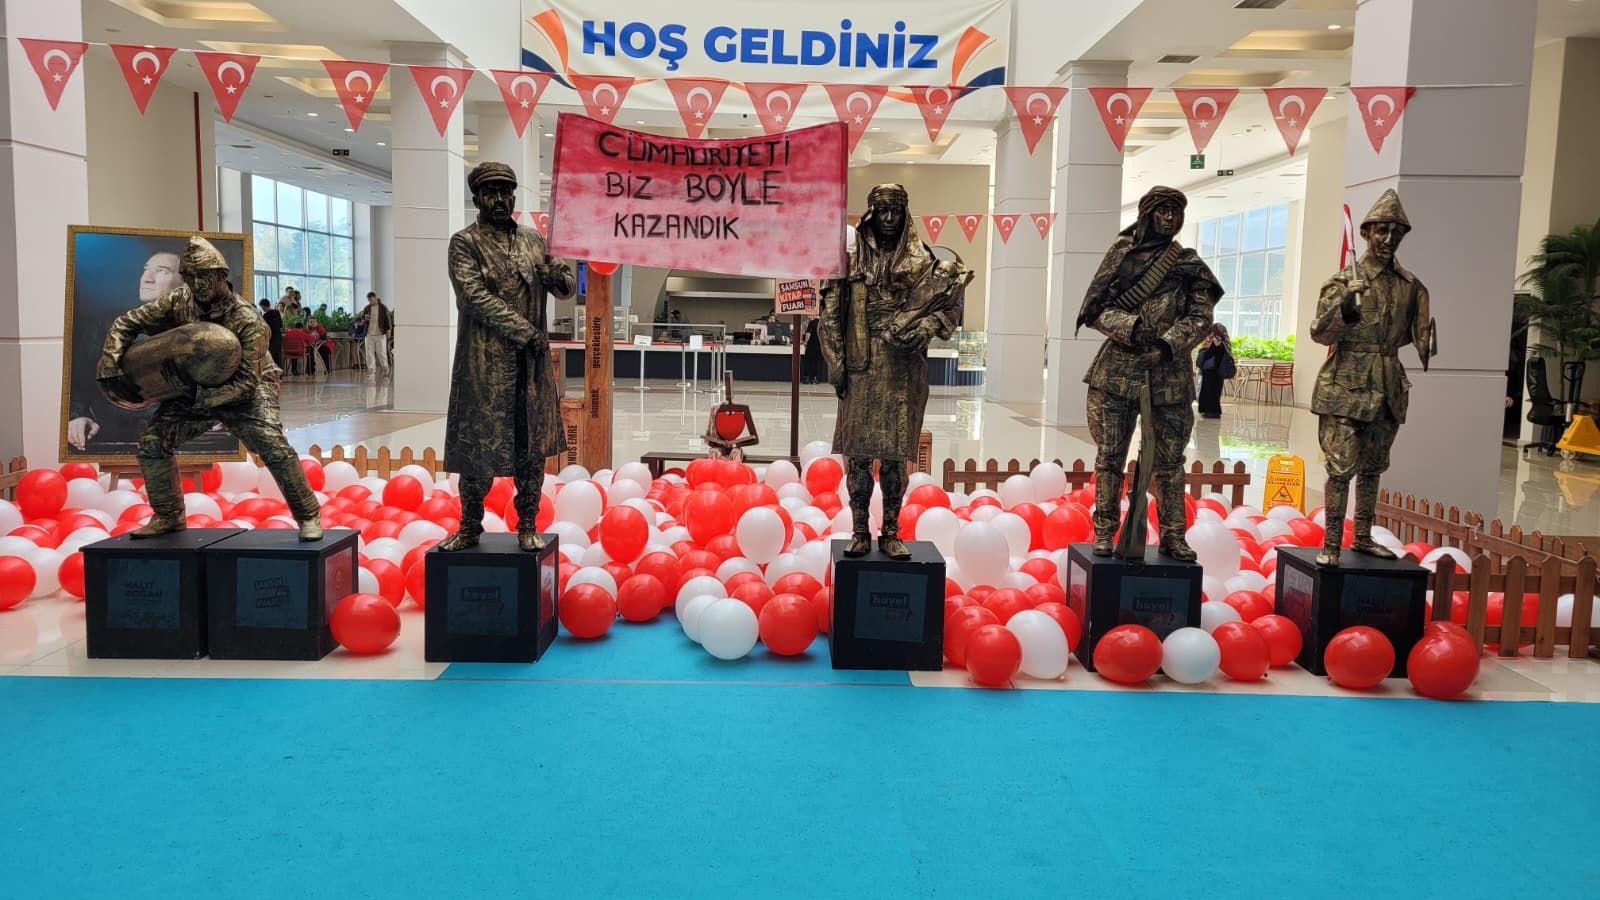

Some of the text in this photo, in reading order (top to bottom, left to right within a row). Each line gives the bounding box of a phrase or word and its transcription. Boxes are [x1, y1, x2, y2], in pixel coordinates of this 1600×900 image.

[582, 19, 939, 71] HOŞ GELDİNİZ
[605, 166, 784, 205] BİZ BÖYLE
[613, 213, 740, 240] KAZANDIK
[780, 280, 808, 292] SAMSUN
[782, 300, 805, 312] FUARI
[567, 424, 578, 445] EMRE
